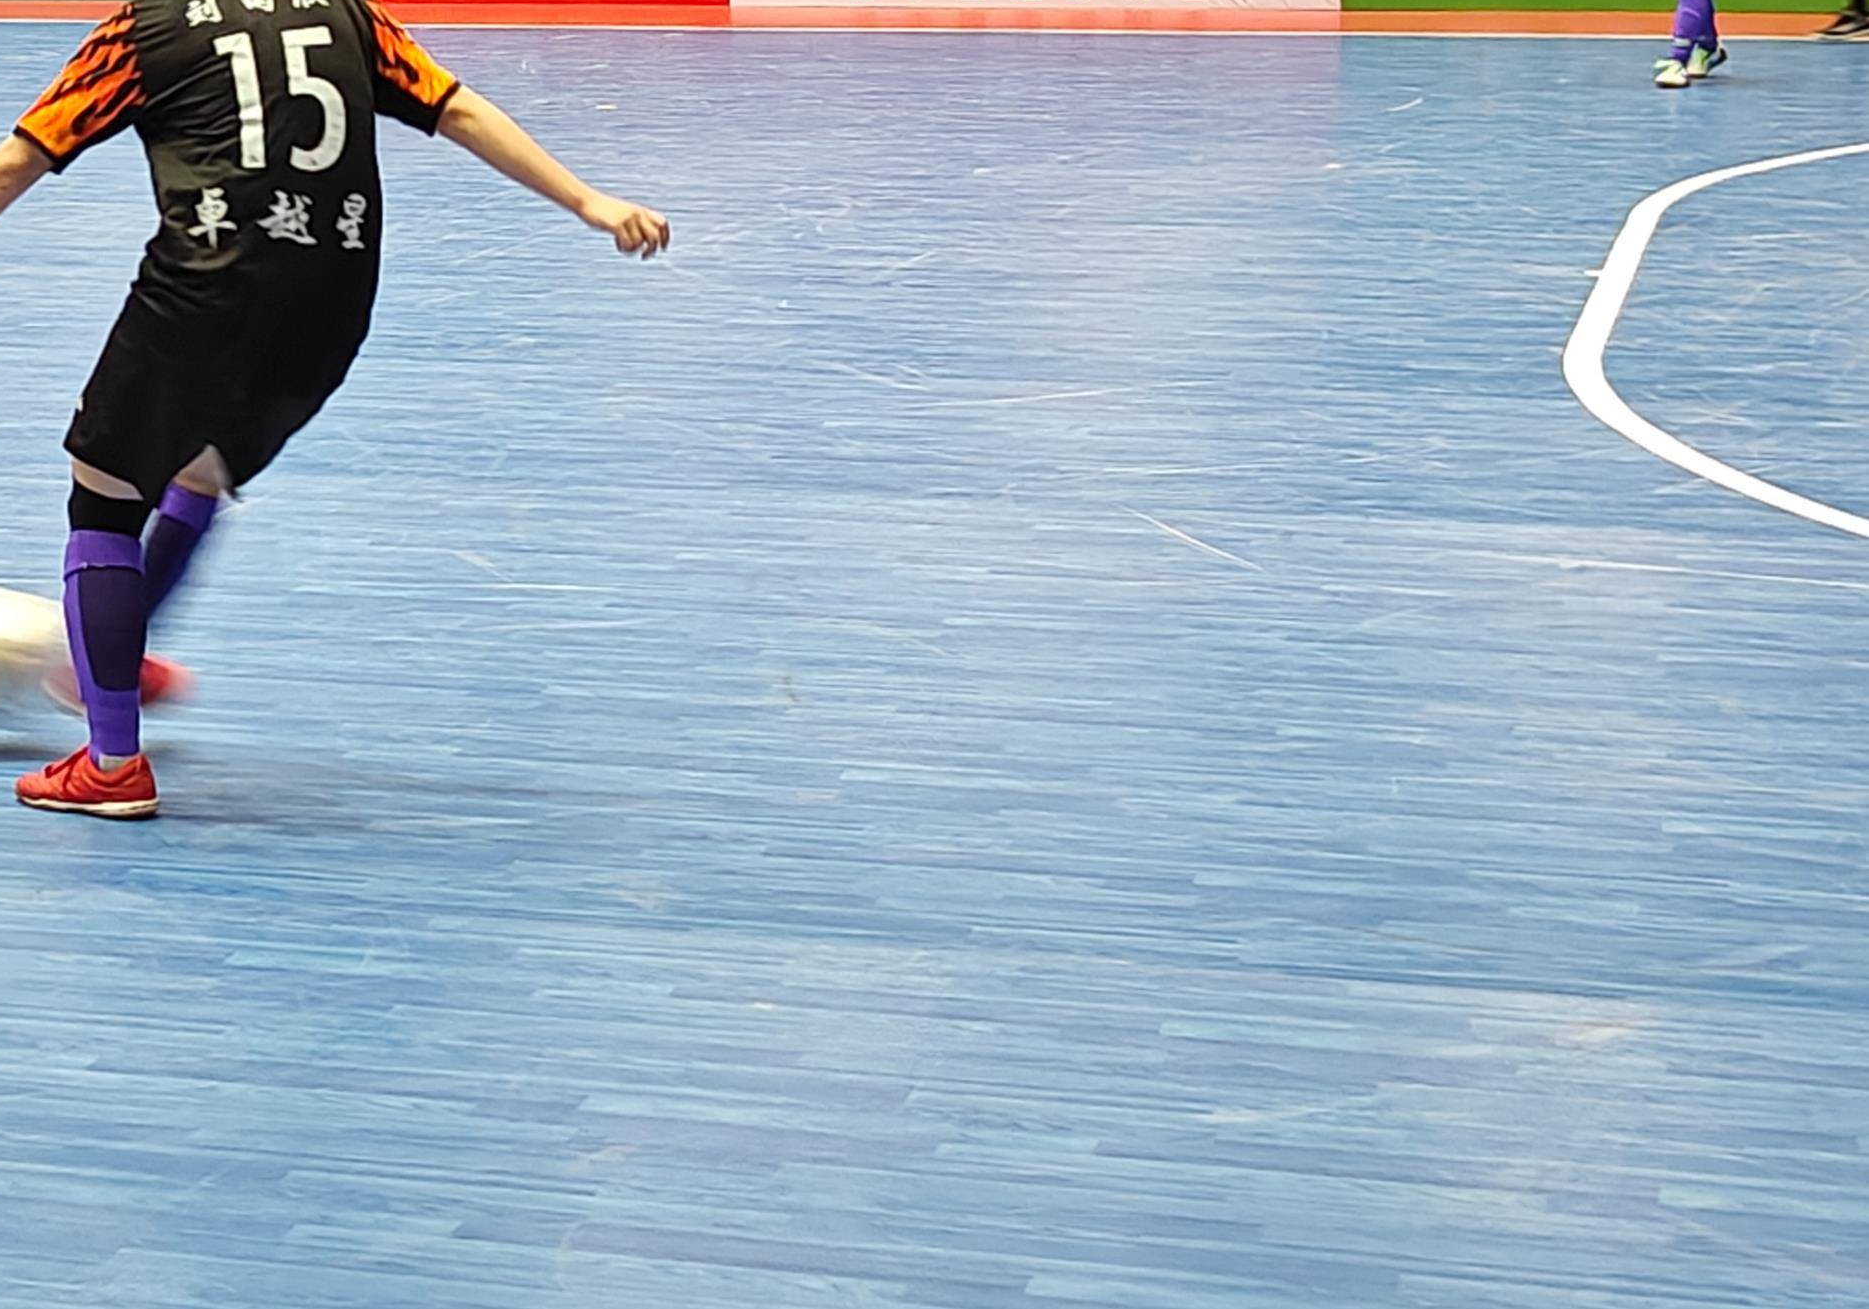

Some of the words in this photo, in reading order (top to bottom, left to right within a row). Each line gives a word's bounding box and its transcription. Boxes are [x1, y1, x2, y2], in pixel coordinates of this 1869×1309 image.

[213, 25, 347, 172] 15
[187, 187, 367, 250] 卓越星
